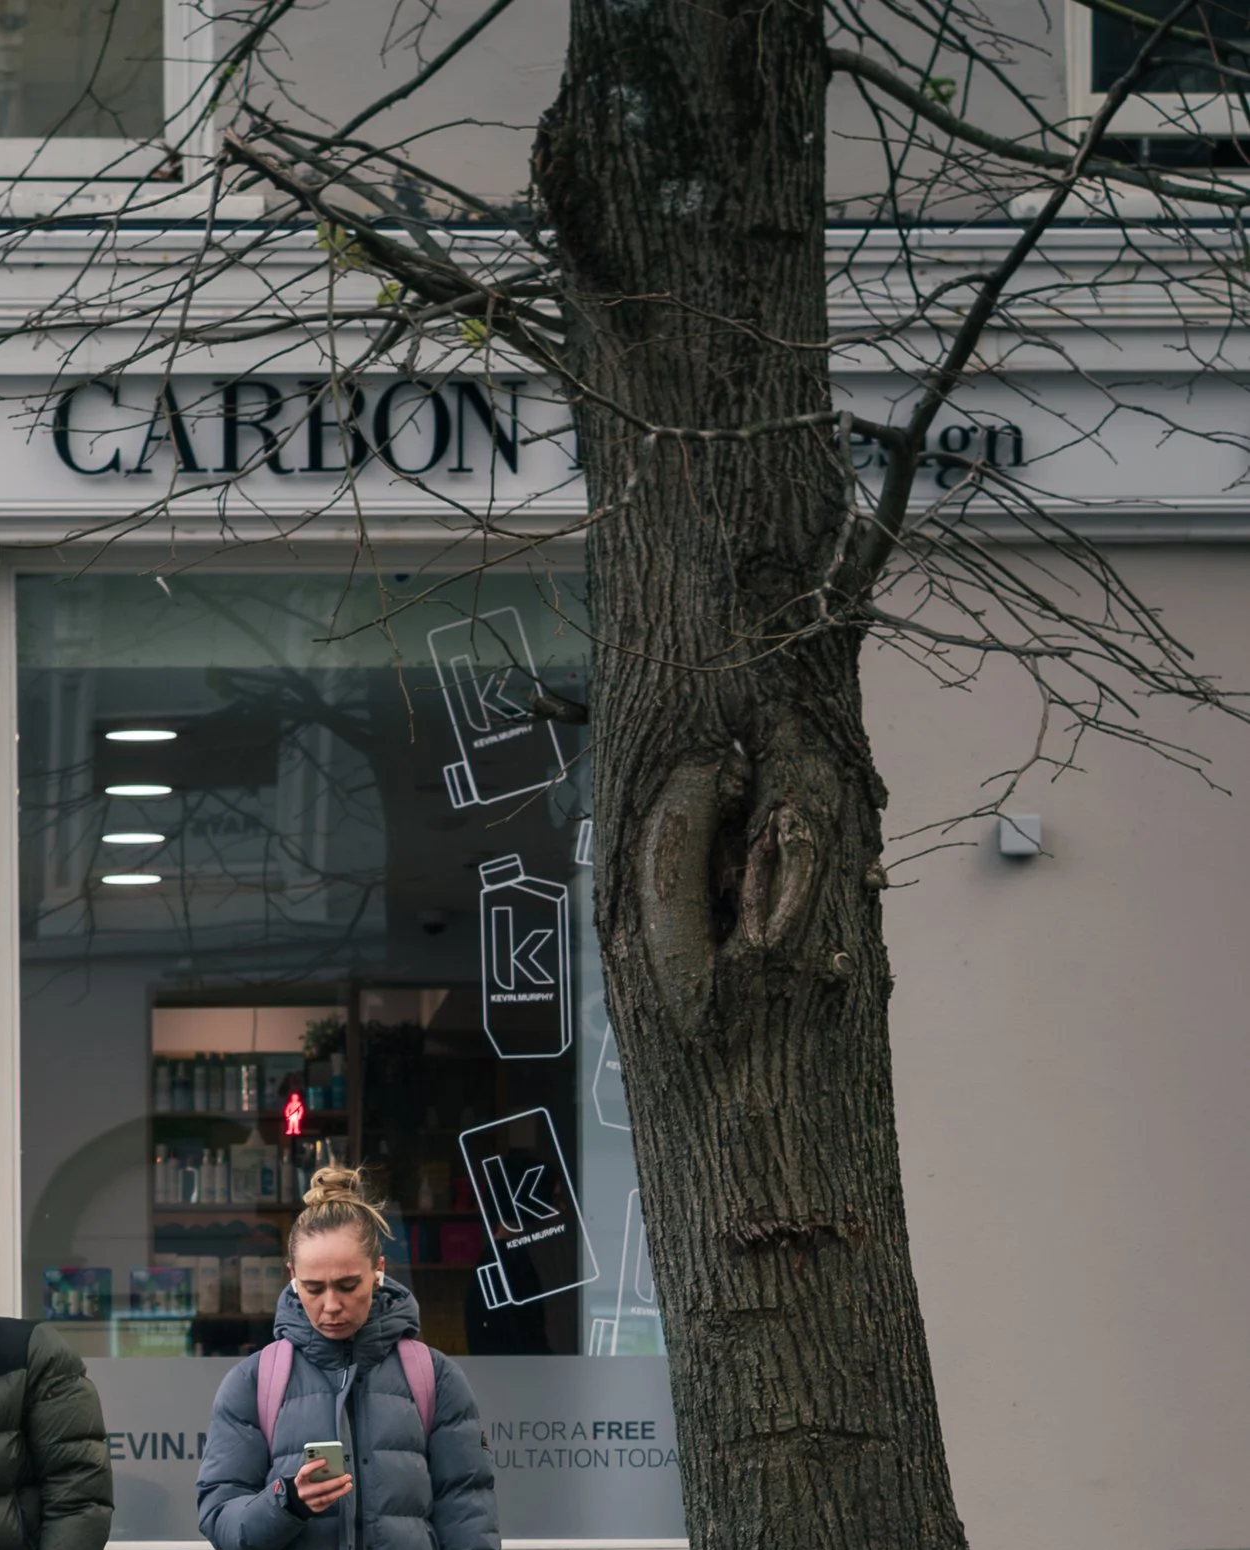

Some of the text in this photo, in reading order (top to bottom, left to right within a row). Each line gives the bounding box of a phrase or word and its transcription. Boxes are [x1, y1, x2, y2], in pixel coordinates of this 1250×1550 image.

[52, 379, 527, 476] CARBON
[491, 1421, 656, 1441] IN FOR A FREE
[491, 1449, 680, 1468] ULTATION TODA
